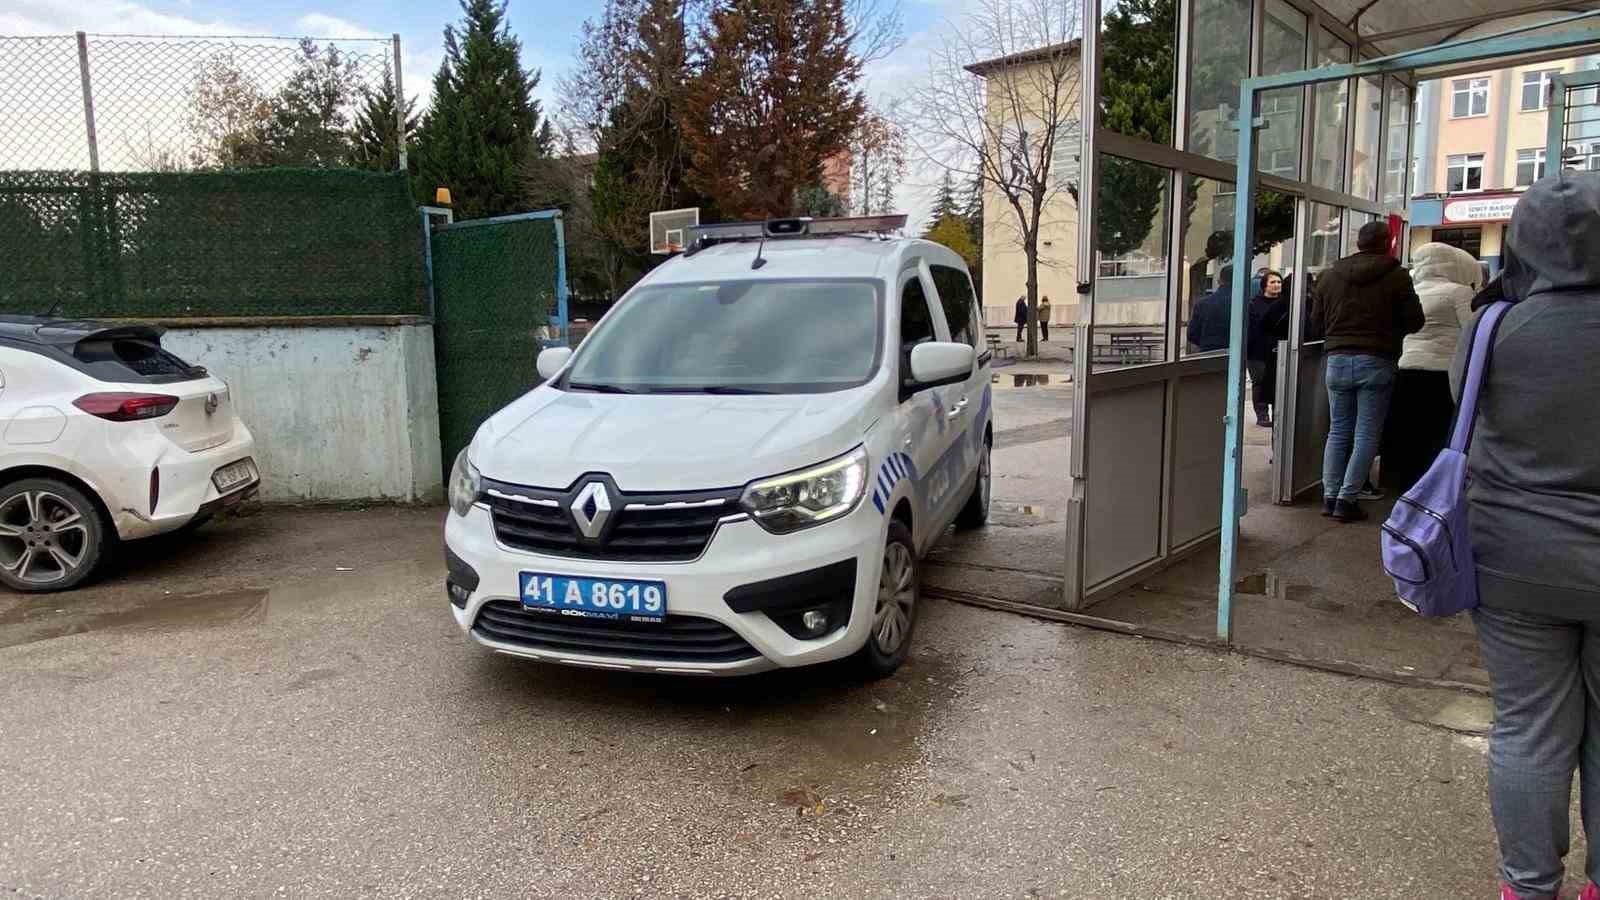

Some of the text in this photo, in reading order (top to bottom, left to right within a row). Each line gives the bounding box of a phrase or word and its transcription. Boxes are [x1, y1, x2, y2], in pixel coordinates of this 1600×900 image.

[525, 576, 661, 611] 41 A 8619
